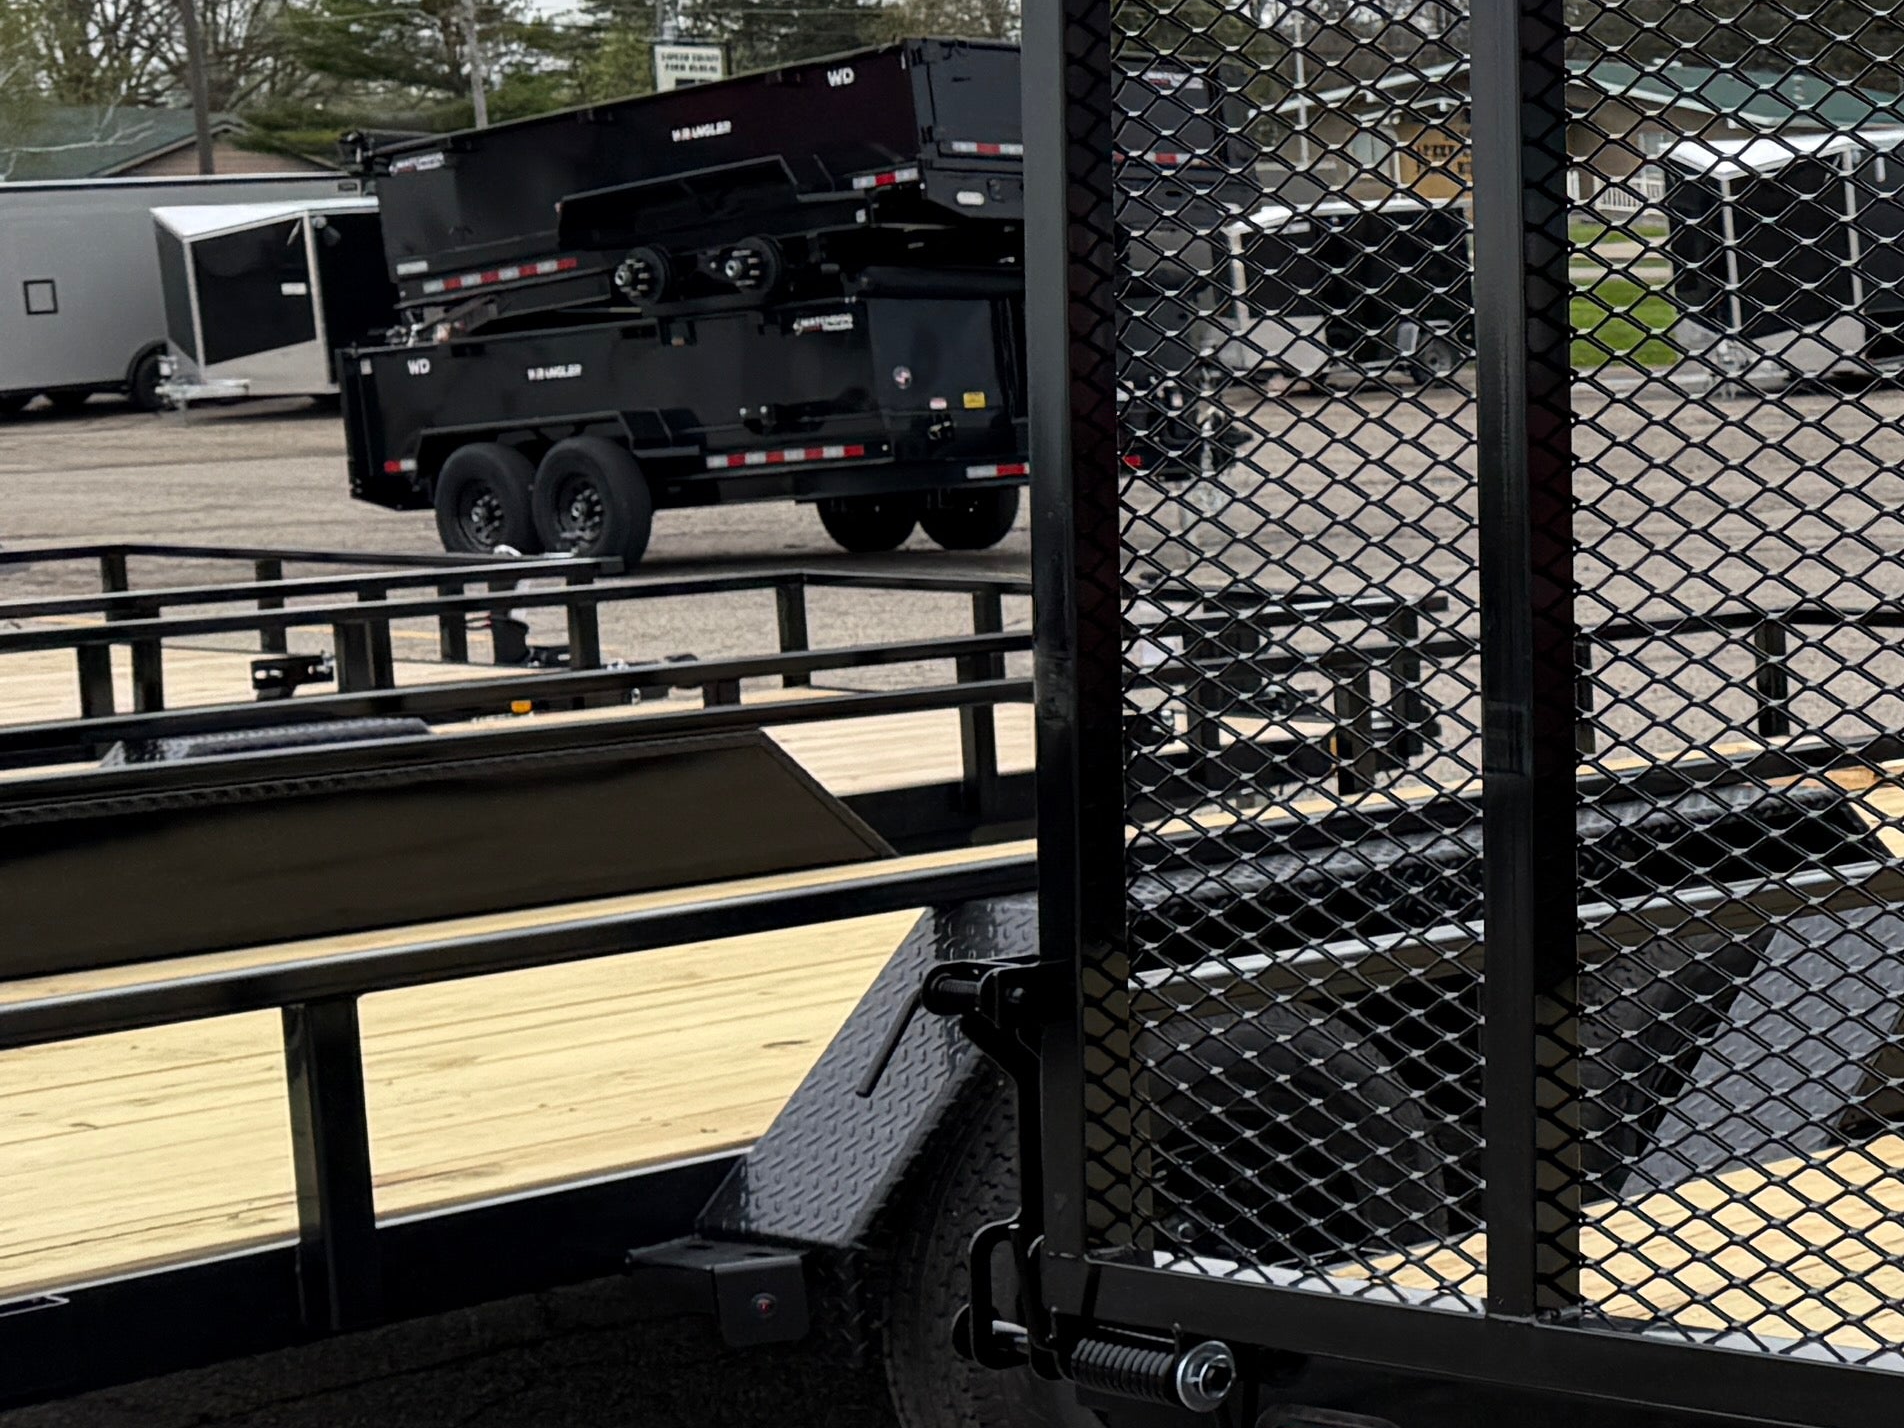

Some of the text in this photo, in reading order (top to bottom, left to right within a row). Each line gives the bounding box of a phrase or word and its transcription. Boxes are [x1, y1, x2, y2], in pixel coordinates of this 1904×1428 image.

[827, 66, 855, 87] WD
[671, 120, 732, 142] WRANGLER
[407, 358, 431, 376] WD
[527, 363, 582, 381] WRANGLER
